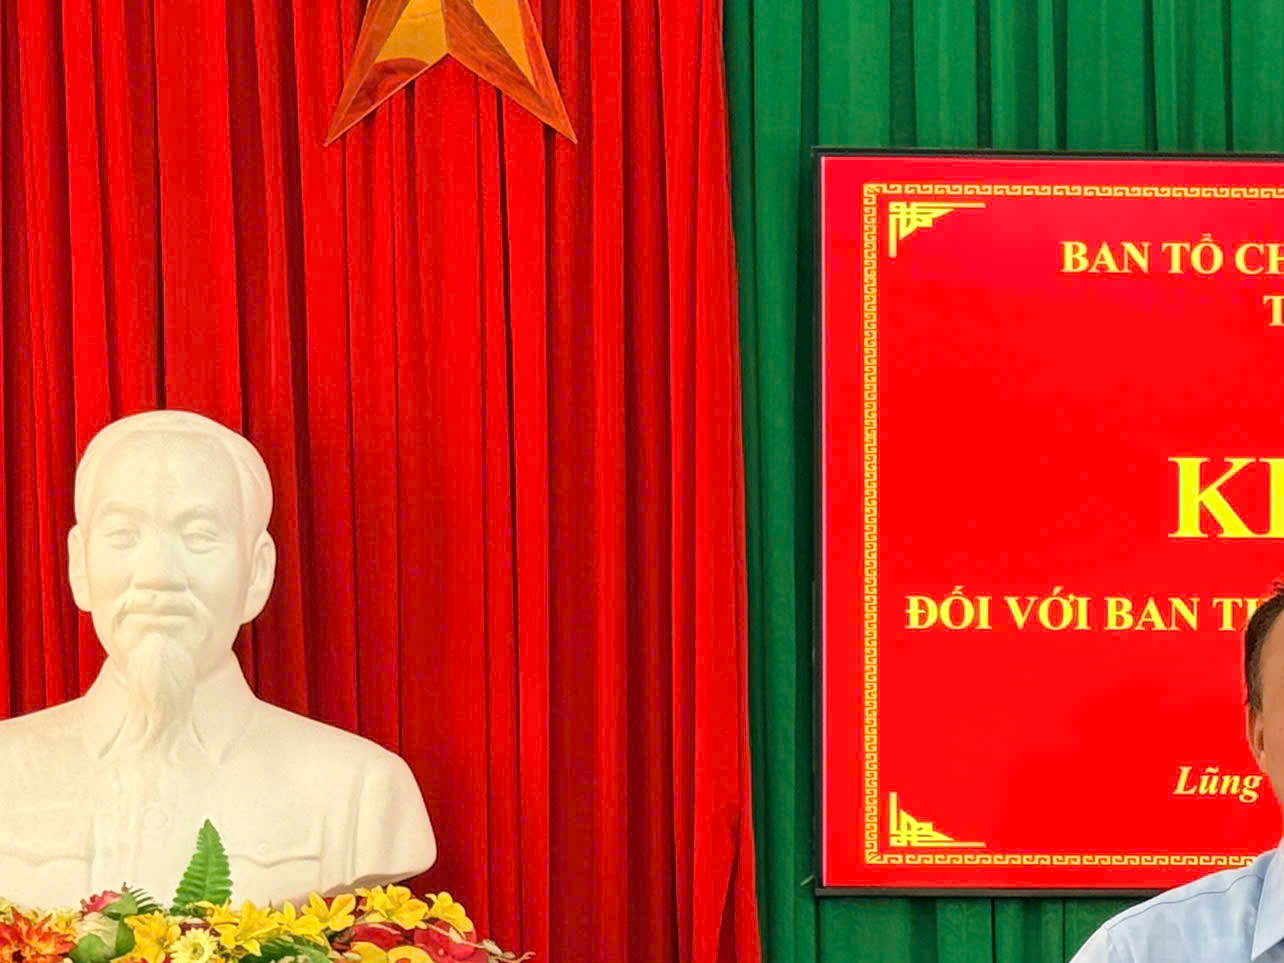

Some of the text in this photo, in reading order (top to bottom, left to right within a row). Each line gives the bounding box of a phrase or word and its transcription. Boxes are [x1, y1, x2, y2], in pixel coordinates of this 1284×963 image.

[1062, 241, 1149, 273] BAN
[1161, 233, 1224, 275] TỔ
[905, 586, 993, 631] ĐỐI
[1004, 586, 1091, 631] VỚI
[1104, 597, 1201, 631] BAN
[1174, 765, 1263, 803] Lũng
